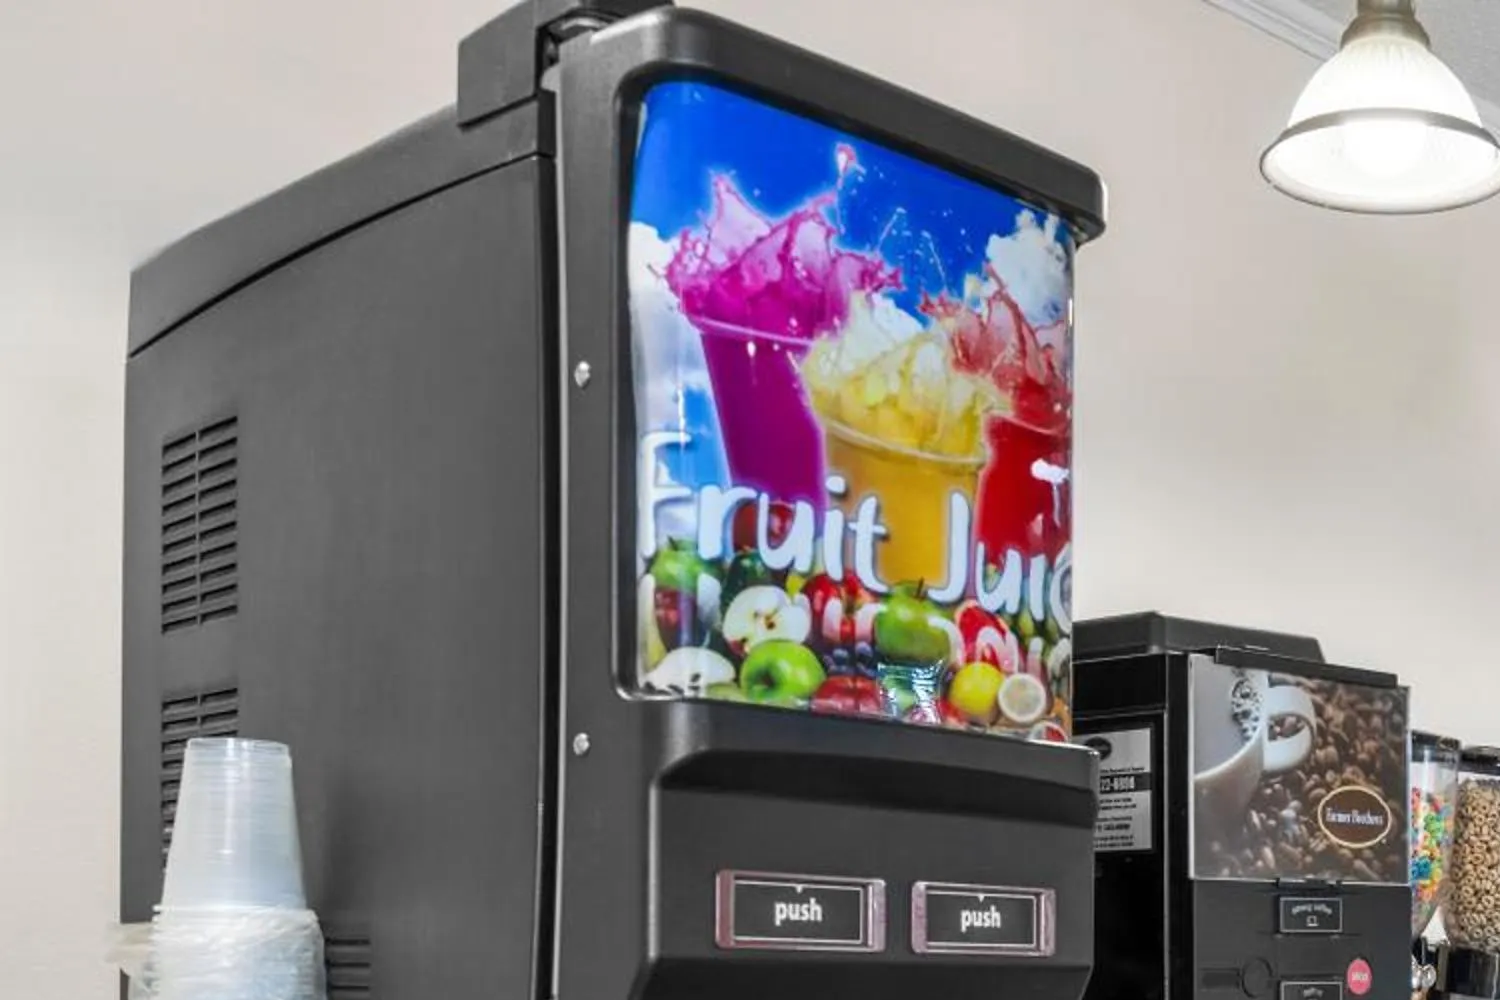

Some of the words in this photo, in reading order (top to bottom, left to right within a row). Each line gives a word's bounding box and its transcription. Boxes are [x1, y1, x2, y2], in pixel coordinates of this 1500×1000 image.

[637, 431, 888, 593] Fruit
[774, 897, 823, 927] push
[960, 904, 1002, 933] push
